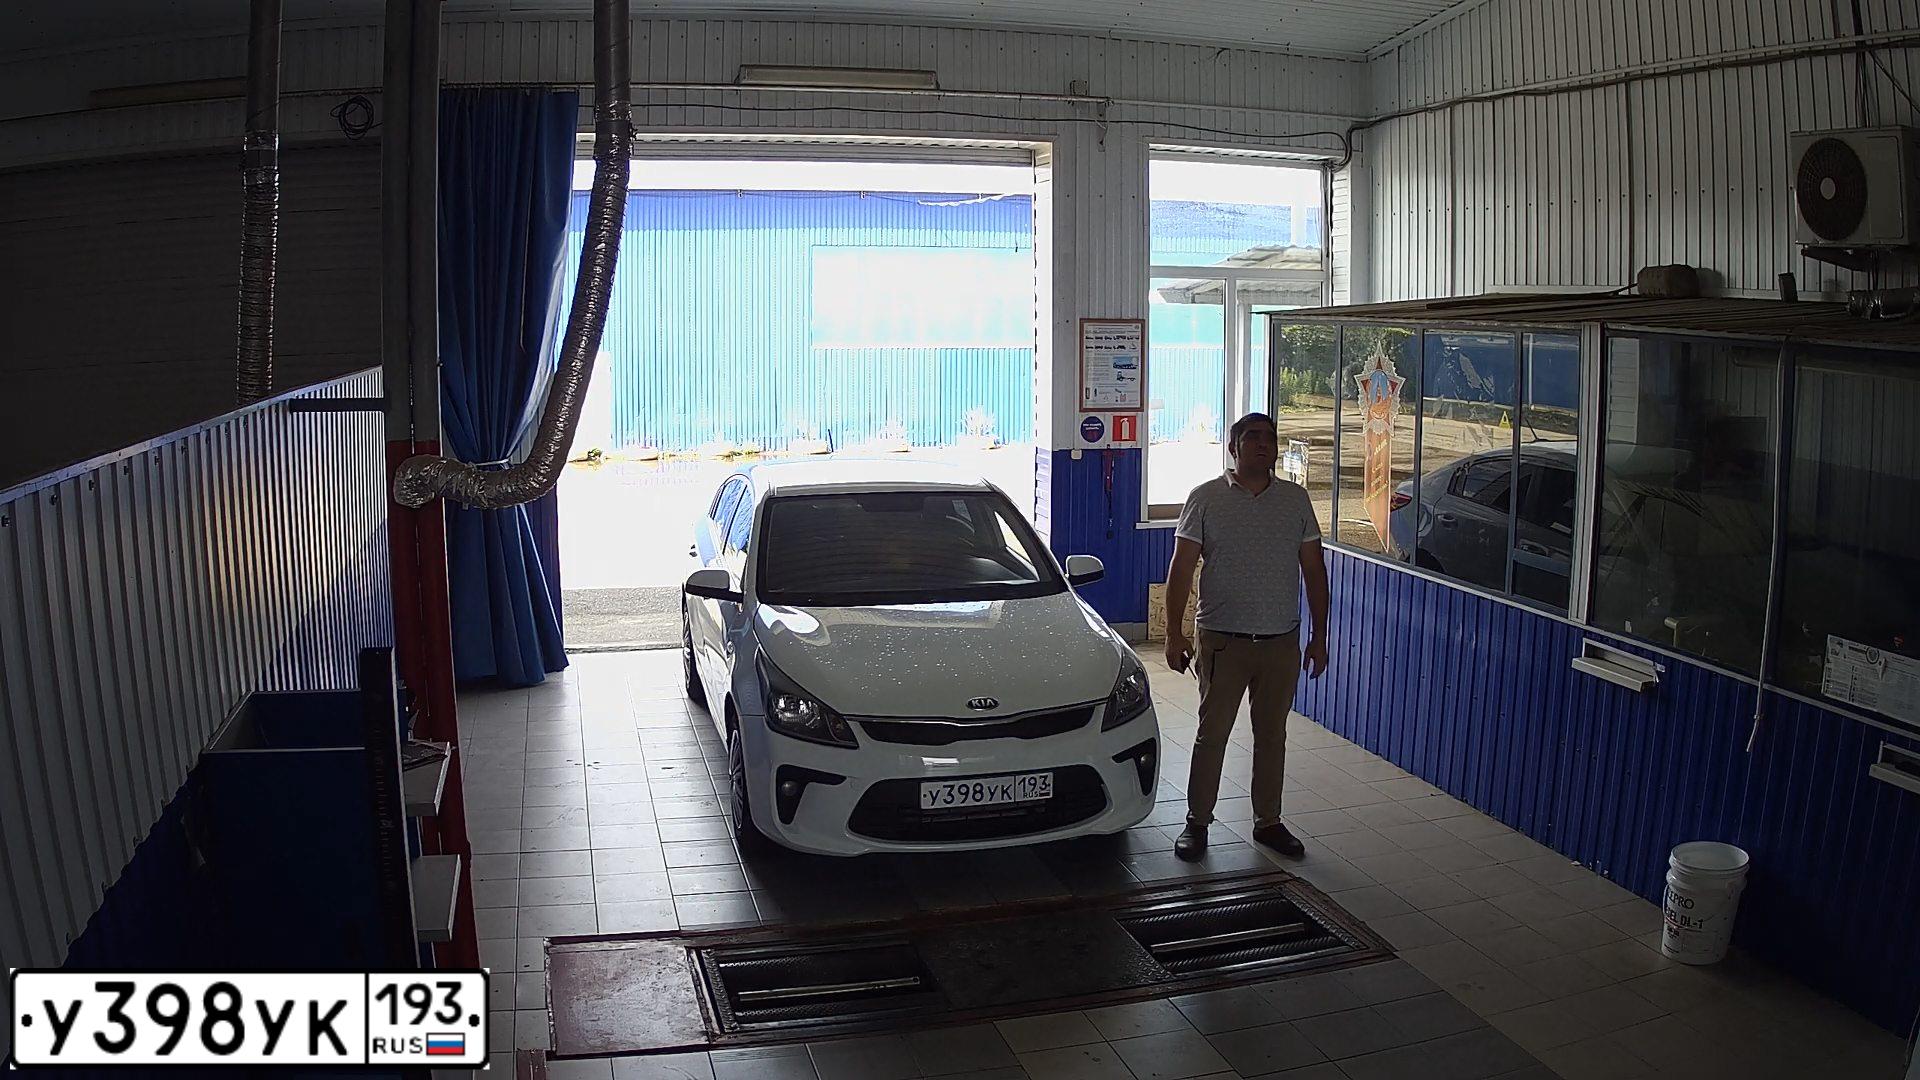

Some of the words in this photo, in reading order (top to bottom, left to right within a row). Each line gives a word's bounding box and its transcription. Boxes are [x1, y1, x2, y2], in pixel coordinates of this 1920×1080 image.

[971, 699, 995, 707] KIA
[928, 782, 1013, 807] У398УК
[1018, 775, 1049, 793] 193
[1024, 791, 1039, 799] RUS
